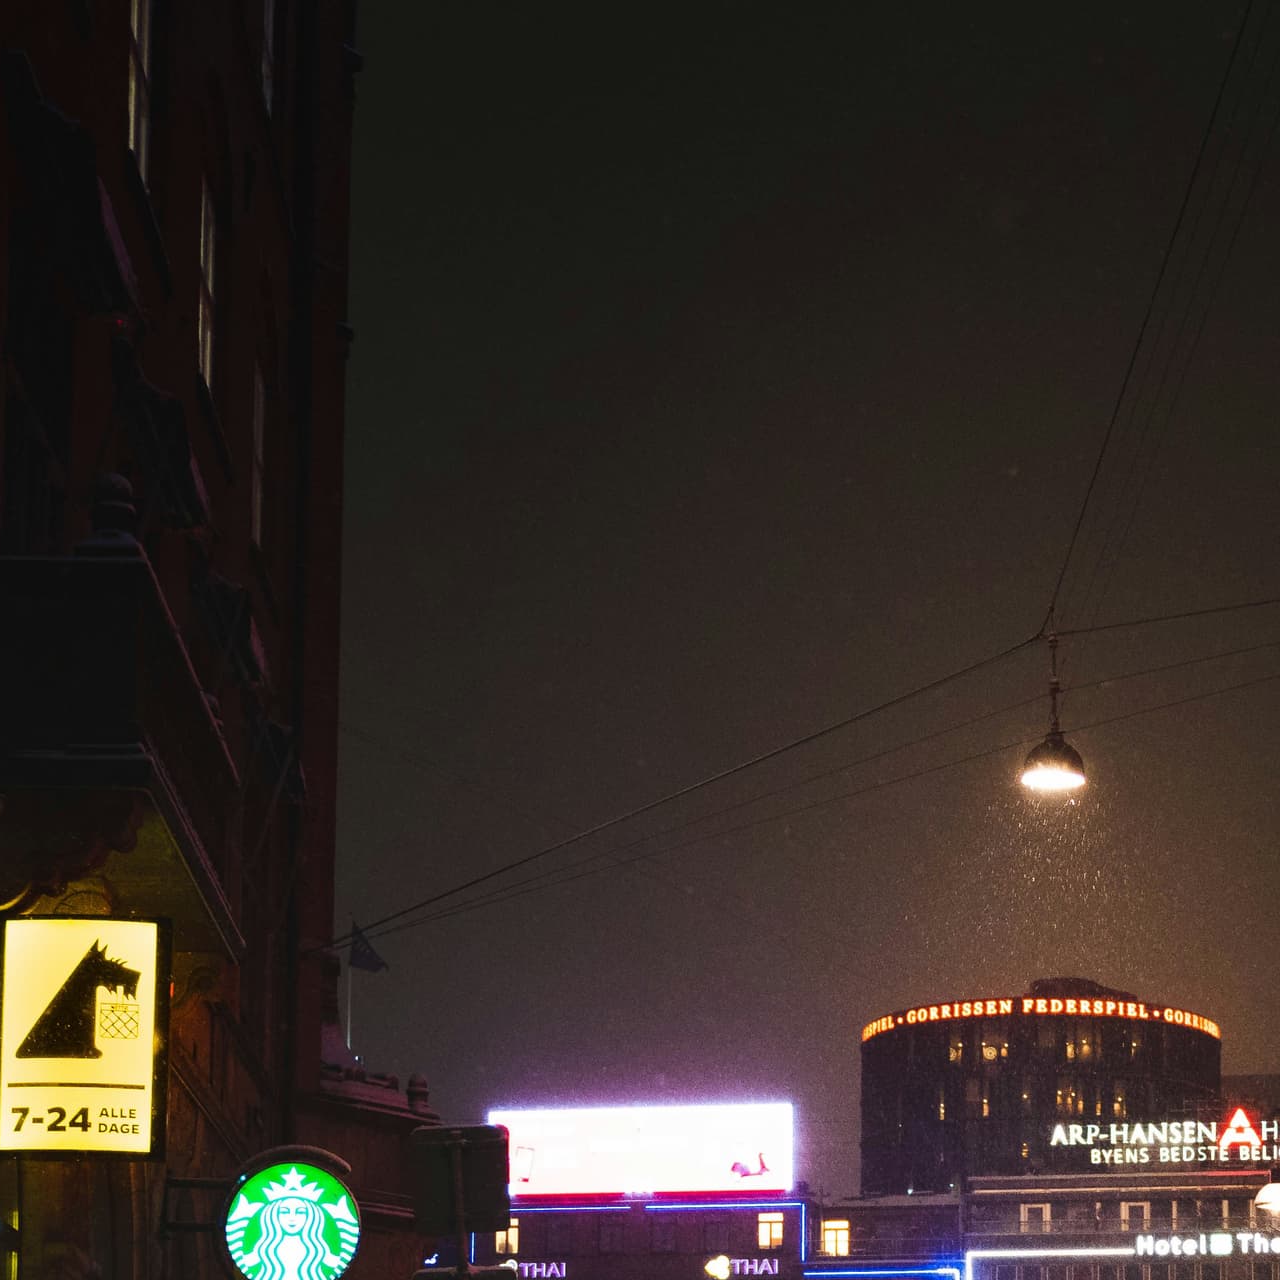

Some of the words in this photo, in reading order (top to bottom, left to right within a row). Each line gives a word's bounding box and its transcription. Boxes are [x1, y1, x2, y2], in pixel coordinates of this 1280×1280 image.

[907, 999, 1012, 1024] GORRISSEN
[1022, 998, 1148, 1019] FEDERSPIEL
[11, 1106, 92, 1132] 7-24
[99, 1107, 136, 1119] ALLE
[98, 1122, 140, 1134] DAGE
[1050, 1121, 1216, 1146] ARP-HANSEN
[1090, 1147, 1149, 1164] BYENS
[1159, 1146, 1229, 1162] BEDSTE
[1136, 1234, 1207, 1256] Hotel
[519, 1261, 567, 1279] THAI
[730, 1258, 779, 1276] THAI
